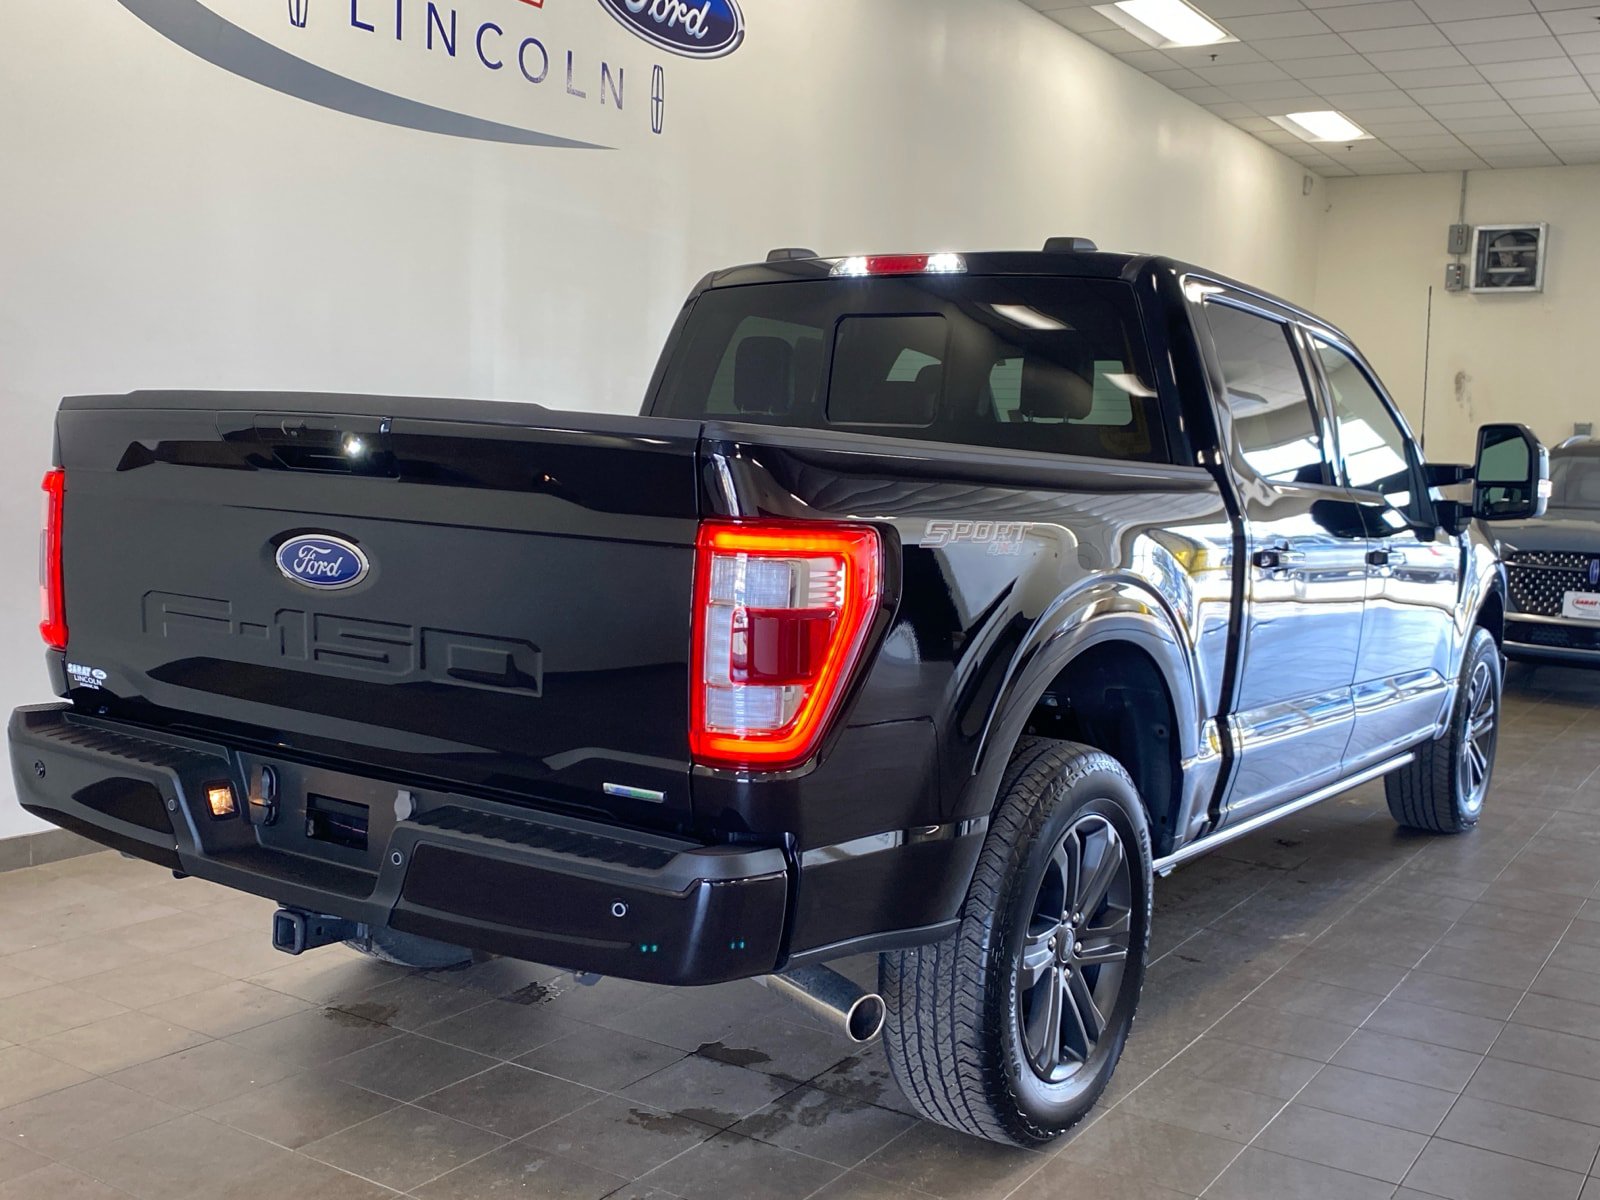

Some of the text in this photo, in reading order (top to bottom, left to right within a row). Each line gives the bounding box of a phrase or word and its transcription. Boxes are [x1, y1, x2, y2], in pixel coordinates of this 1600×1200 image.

[625, 0, 711, 39] ord
[350, 0, 624, 110] LINCOLN
[919, 520, 1034, 548] SPORT
[293, 545, 343, 577] Ford
[142, 590, 542, 697] F-150
[73, 674, 103, 686] LINCOLN
